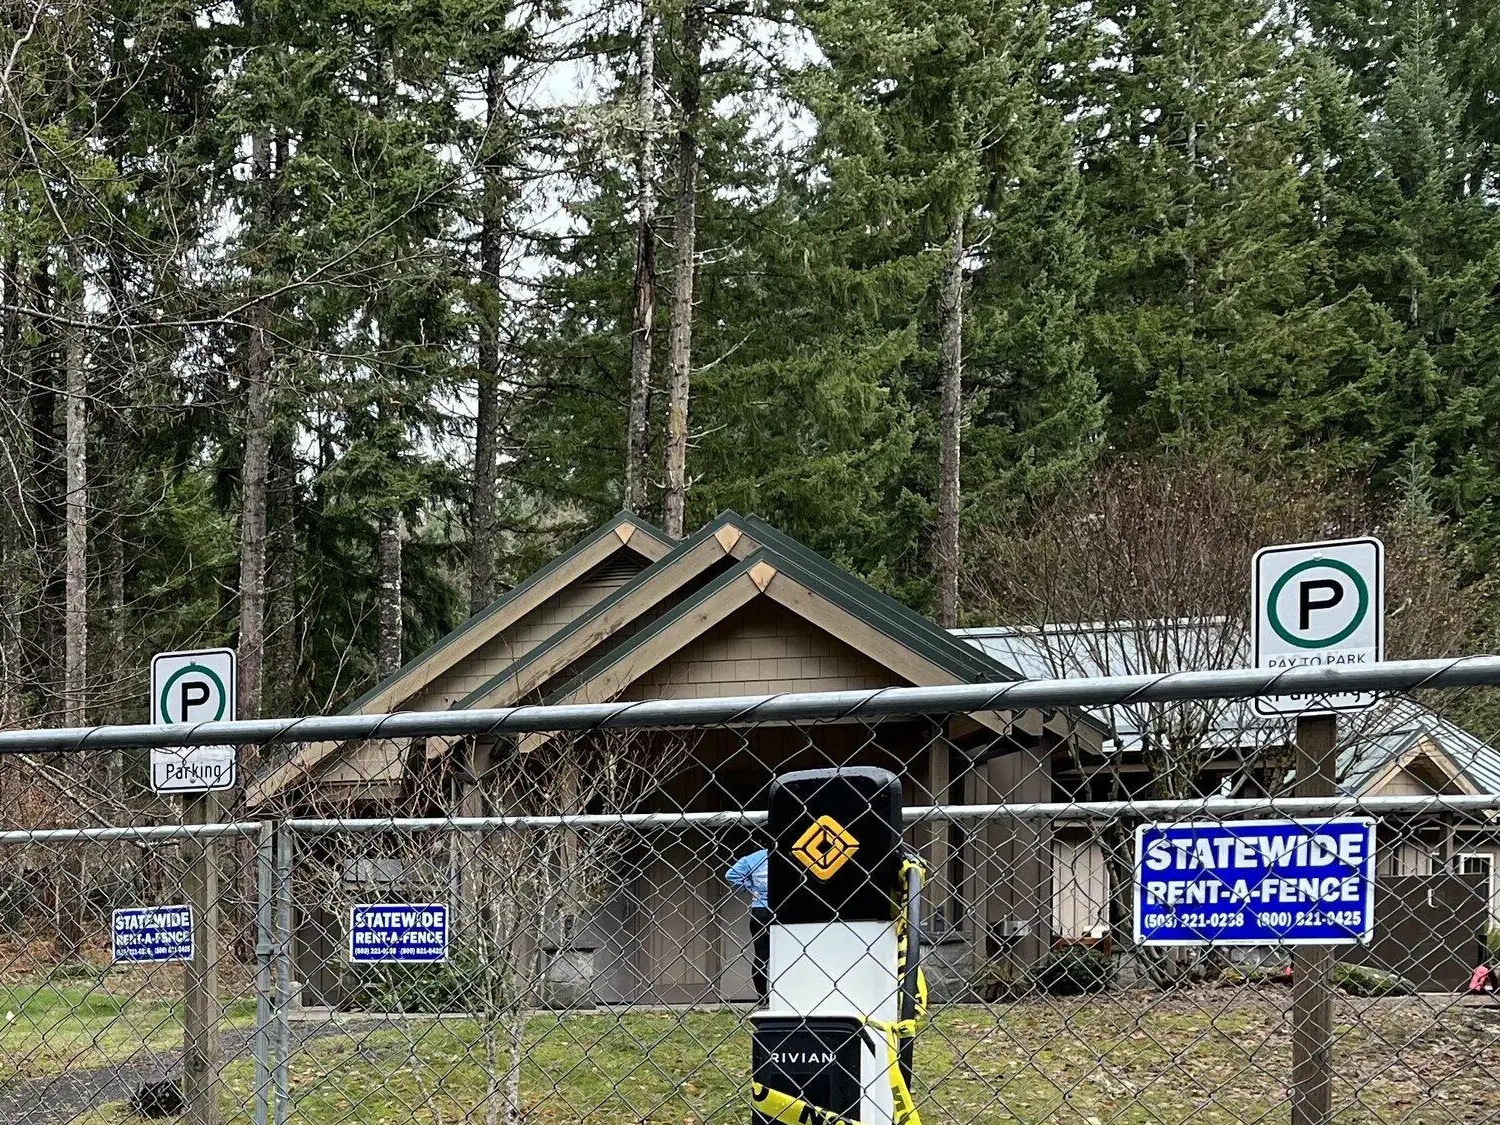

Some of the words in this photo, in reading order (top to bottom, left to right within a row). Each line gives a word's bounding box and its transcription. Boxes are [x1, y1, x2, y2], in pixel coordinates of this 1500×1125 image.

[1300, 579, 1344, 630] P
[1268, 658, 1296, 669] PAY
[1301, 656, 1322, 666] TO
[1327, 653, 1366, 665] PARK
[181, 681, 210, 723] P
[166, 763, 221, 783] Parking
[1145, 834, 1363, 871] STATEWIDE
[1147, 877, 1360, 906] RENT-A-FENCE
[115, 912, 190, 930] STATEWIDE
[355, 911, 444, 928] STATEWIDE
[1144, 914, 1177, 929] (503)
[1181, 912, 1244, 928] 221-0238
[1257, 911, 1291, 927] (800)
[1296, 910, 1361, 926] 821-0425
[355, 931, 444, 944] RENT-A-FENCE
[770, 1052, 834, 1063] RIVIAN
